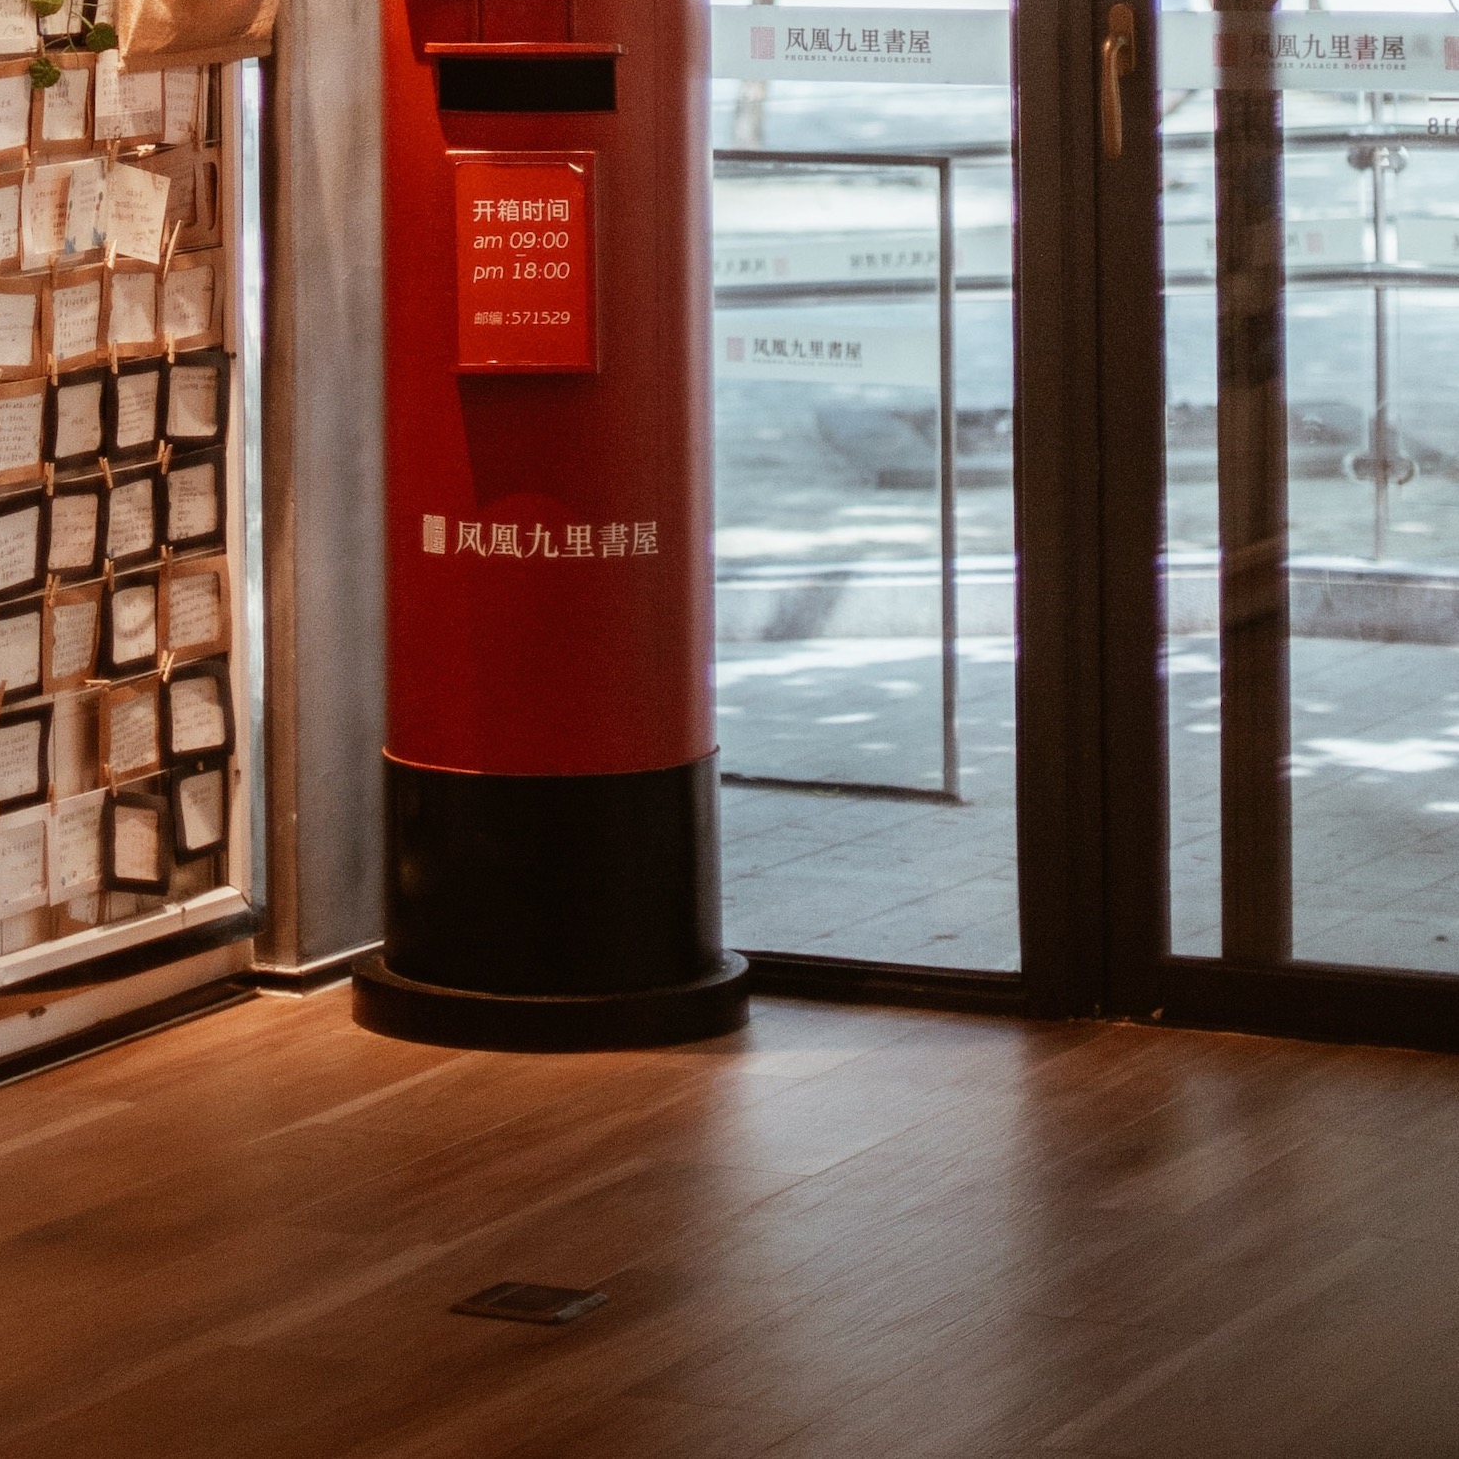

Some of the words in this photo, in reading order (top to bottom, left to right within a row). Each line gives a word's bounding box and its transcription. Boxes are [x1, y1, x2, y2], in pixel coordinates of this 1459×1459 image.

[785, 27, 931, 54] 凤凰九里書屋
[785, 54, 827, 62] PHOENIX
[832, 55, 868, 63] PALACE
[874, 56, 931, 64] BOOKSTORE
[1344, 62, 1406, 71] BOOKSTORE
[472, 198, 570, 222] 开箱时间
[473, 235, 503, 249] am
[509, 231, 569, 249] 09:00
[473, 265, 504, 283] pm
[512, 261, 570, 279] 18:00
[455, 521, 659, 558] 凤凰九里書屋
